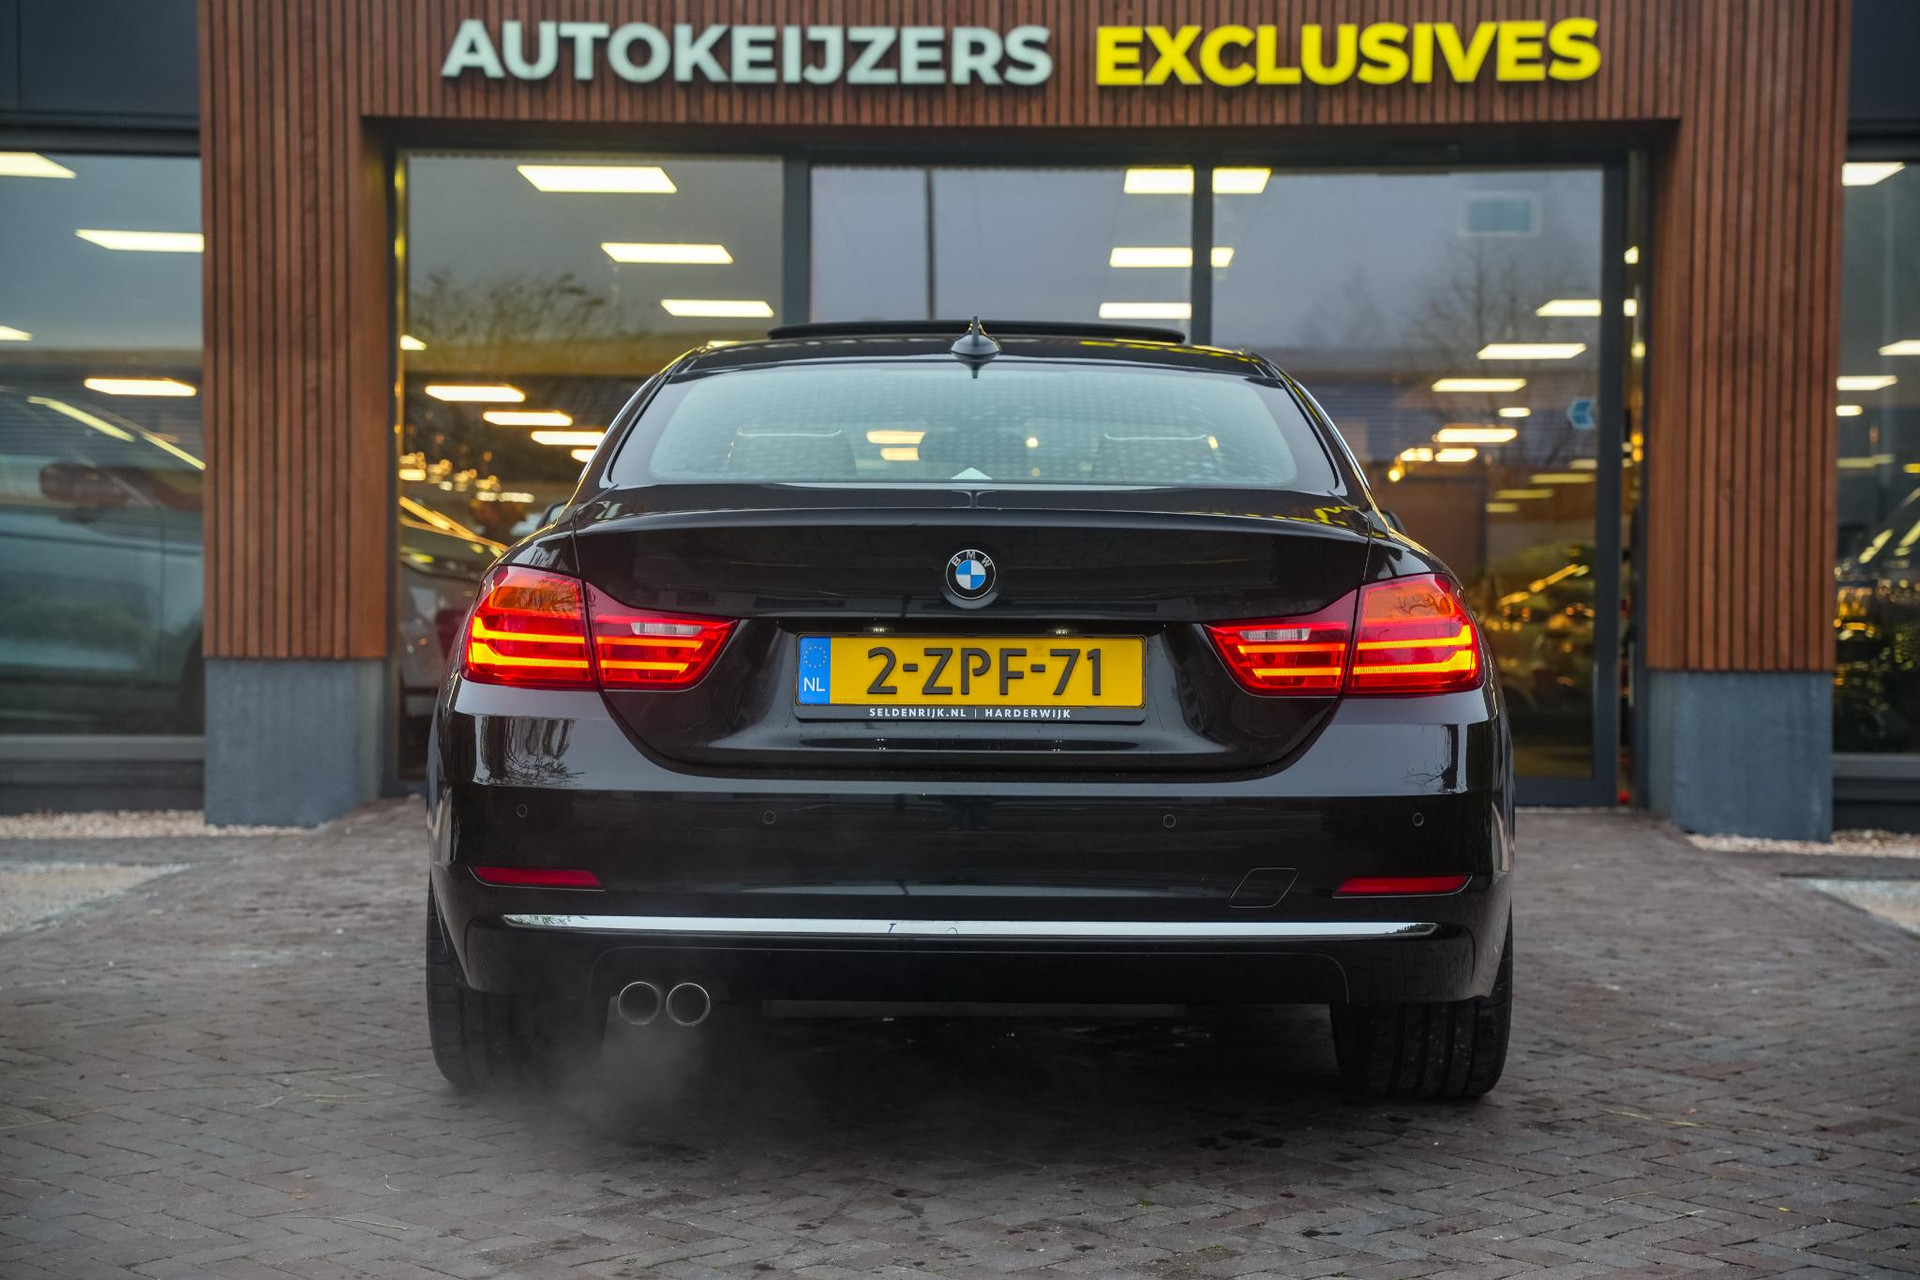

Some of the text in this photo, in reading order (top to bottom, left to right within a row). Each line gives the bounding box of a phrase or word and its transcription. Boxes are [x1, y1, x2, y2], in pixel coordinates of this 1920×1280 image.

[441, 18, 1601, 87] AUTOKEIJZERS EXCLUSIVES
[951, 551, 991, 567] BMW
[867, 647, 1102, 696] 2-ZPF-71
[803, 677, 826, 692] NL
[869, 708, 967, 718] SELDENRIJK.NL
[985, 708, 1072, 719] HARDERWIJK
